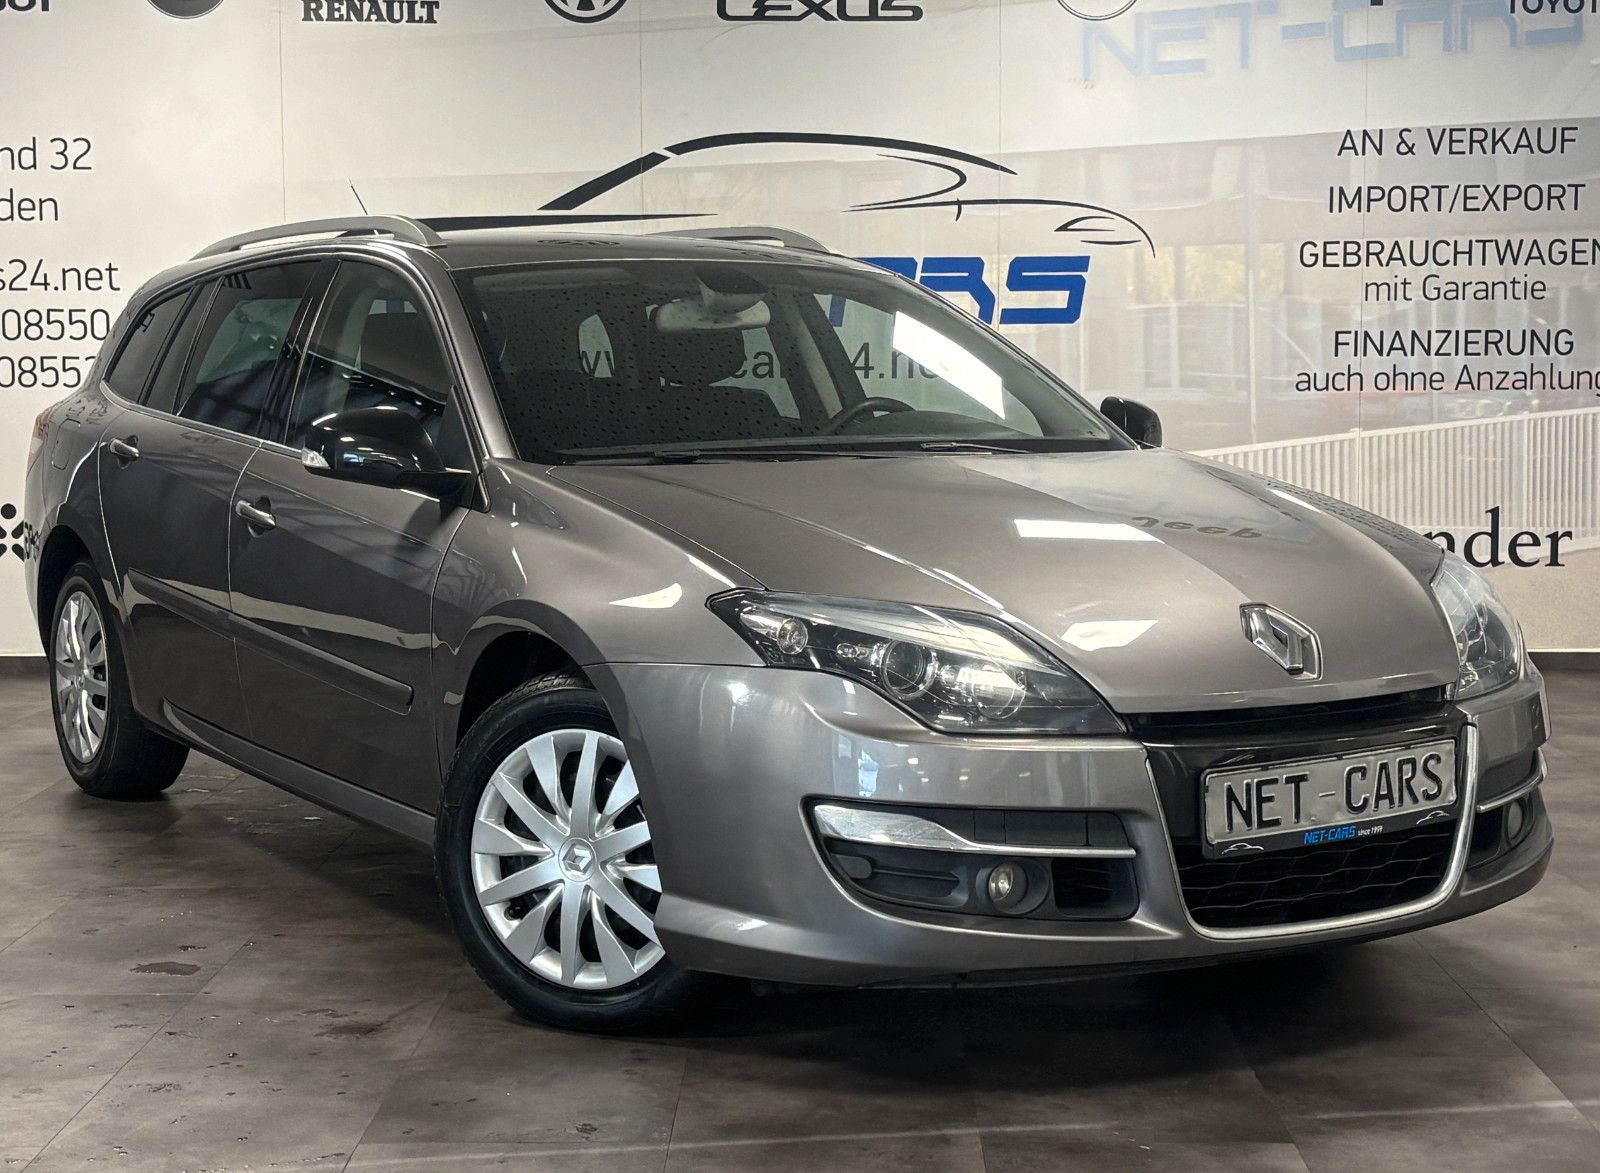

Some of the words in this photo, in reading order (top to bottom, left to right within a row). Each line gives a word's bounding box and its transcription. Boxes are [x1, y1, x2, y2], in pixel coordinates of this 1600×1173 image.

[302, 0, 439, 23] RENAULT
[717, 0, 923, 21] LEXUS
[50, 137, 92, 170] 32
[1337, 129, 1383, 156] AN
[1396, 128, 1416, 156] &
[1426, 126, 1579, 155] VERKAUF
[1328, 183, 1586, 213] IMPORT/EXPORT
[1365, 275, 1412, 301] mit
[1422, 274, 1547, 301] Garantie
[1334, 328, 1574, 357] FINANZIERUNG
[0, 356, 97, 388] 0855
[1295, 364, 1364, 391] auch
[1374, 364, 1445, 391] ohne
[1224, 771, 1310, 833] NET
[1344, 752, 1442, 814] CARS
[1304, 826, 1356, 845] NET-CARS
